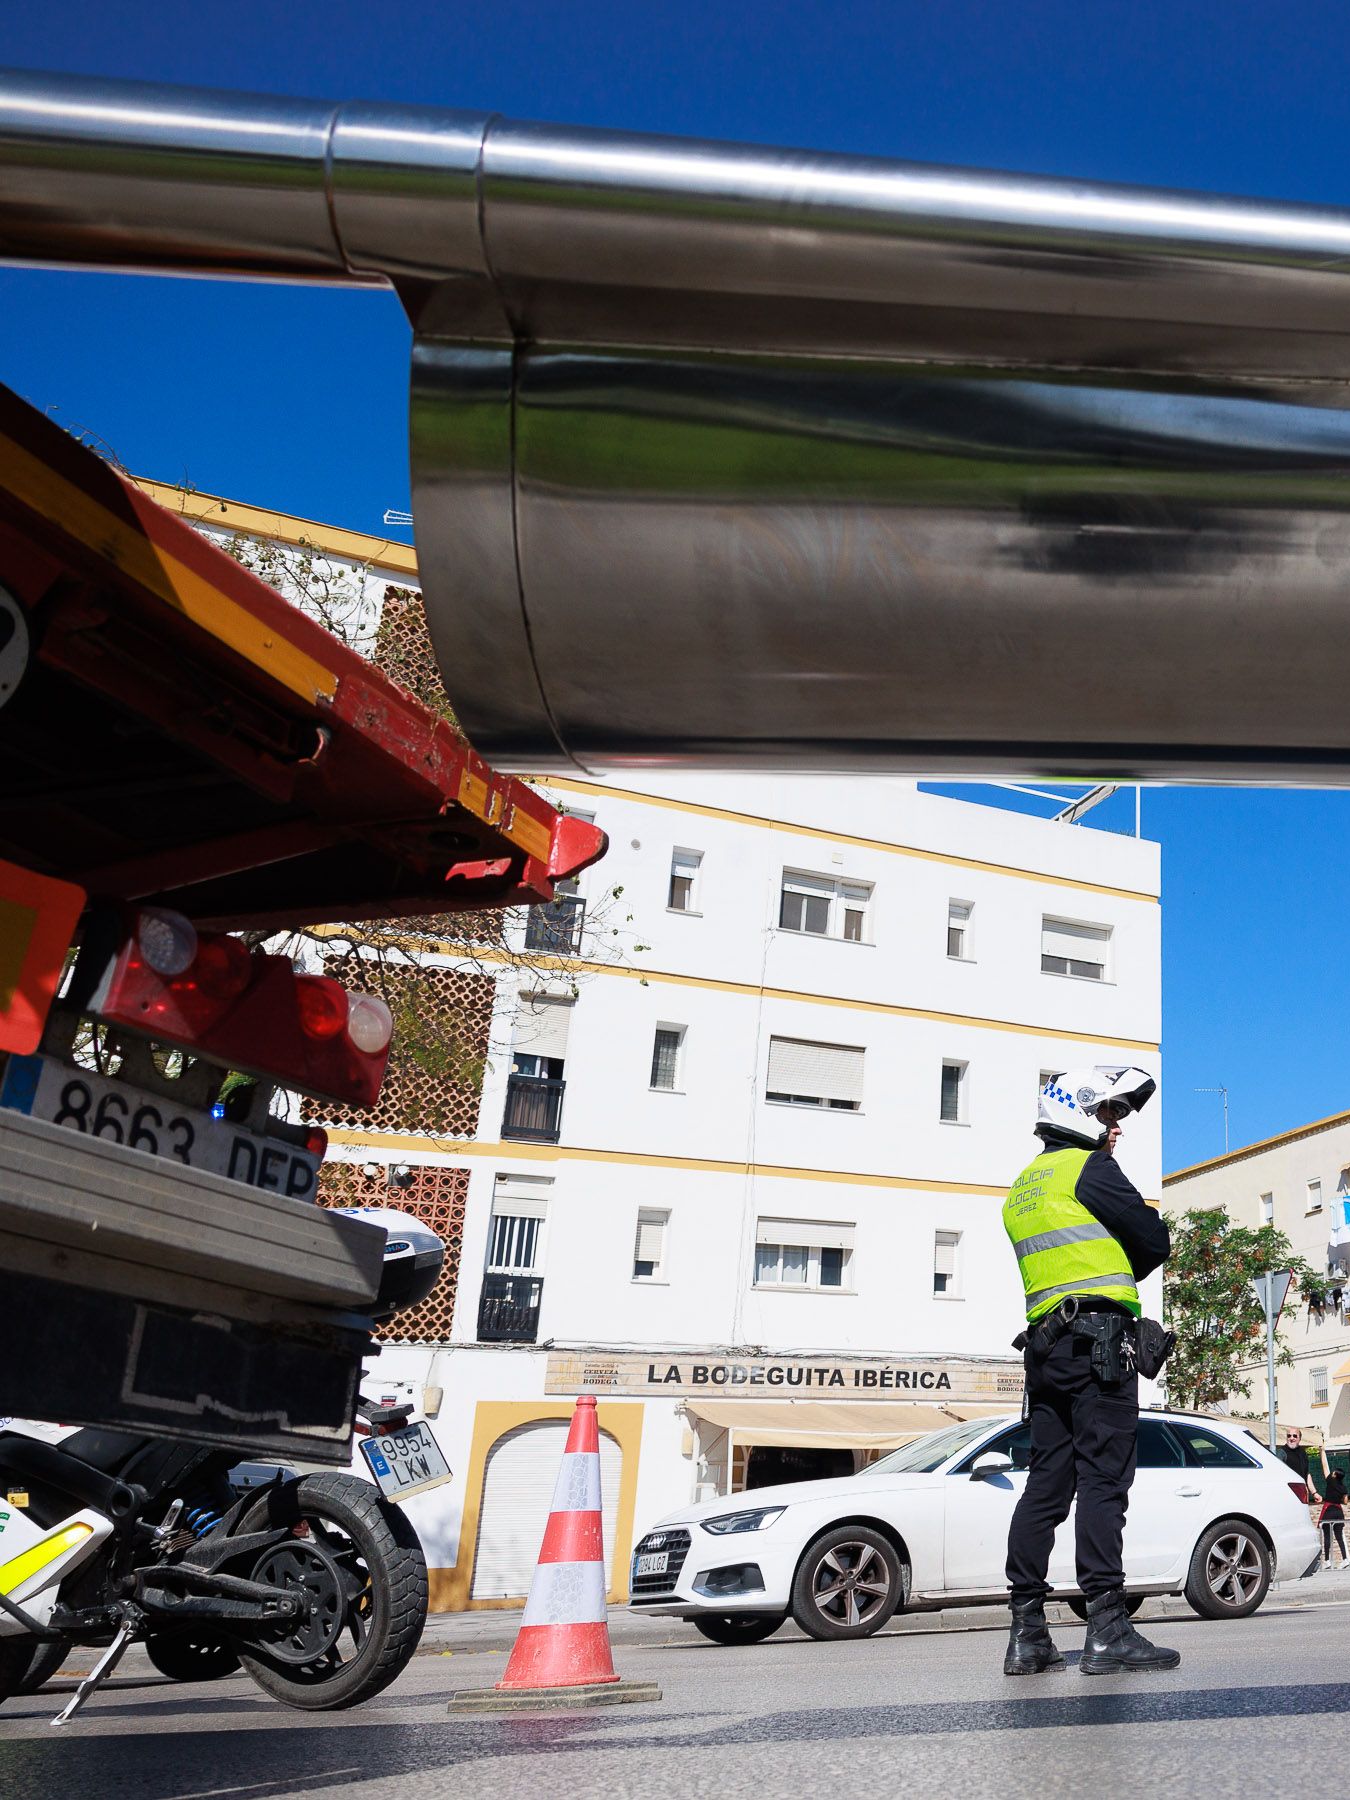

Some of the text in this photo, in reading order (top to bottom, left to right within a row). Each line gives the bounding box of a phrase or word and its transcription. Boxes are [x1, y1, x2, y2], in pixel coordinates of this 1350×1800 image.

[53, 1079, 195, 1166] 8663
[1008, 1186, 1047, 1208] LOCAL
[647, 1364, 951, 1390] LA BODEGUITA IBÉRICA
[381, 1428, 432, 1461] 9954
[376, 1461, 385, 1470] E
[392, 1454, 432, 1486] LKW
